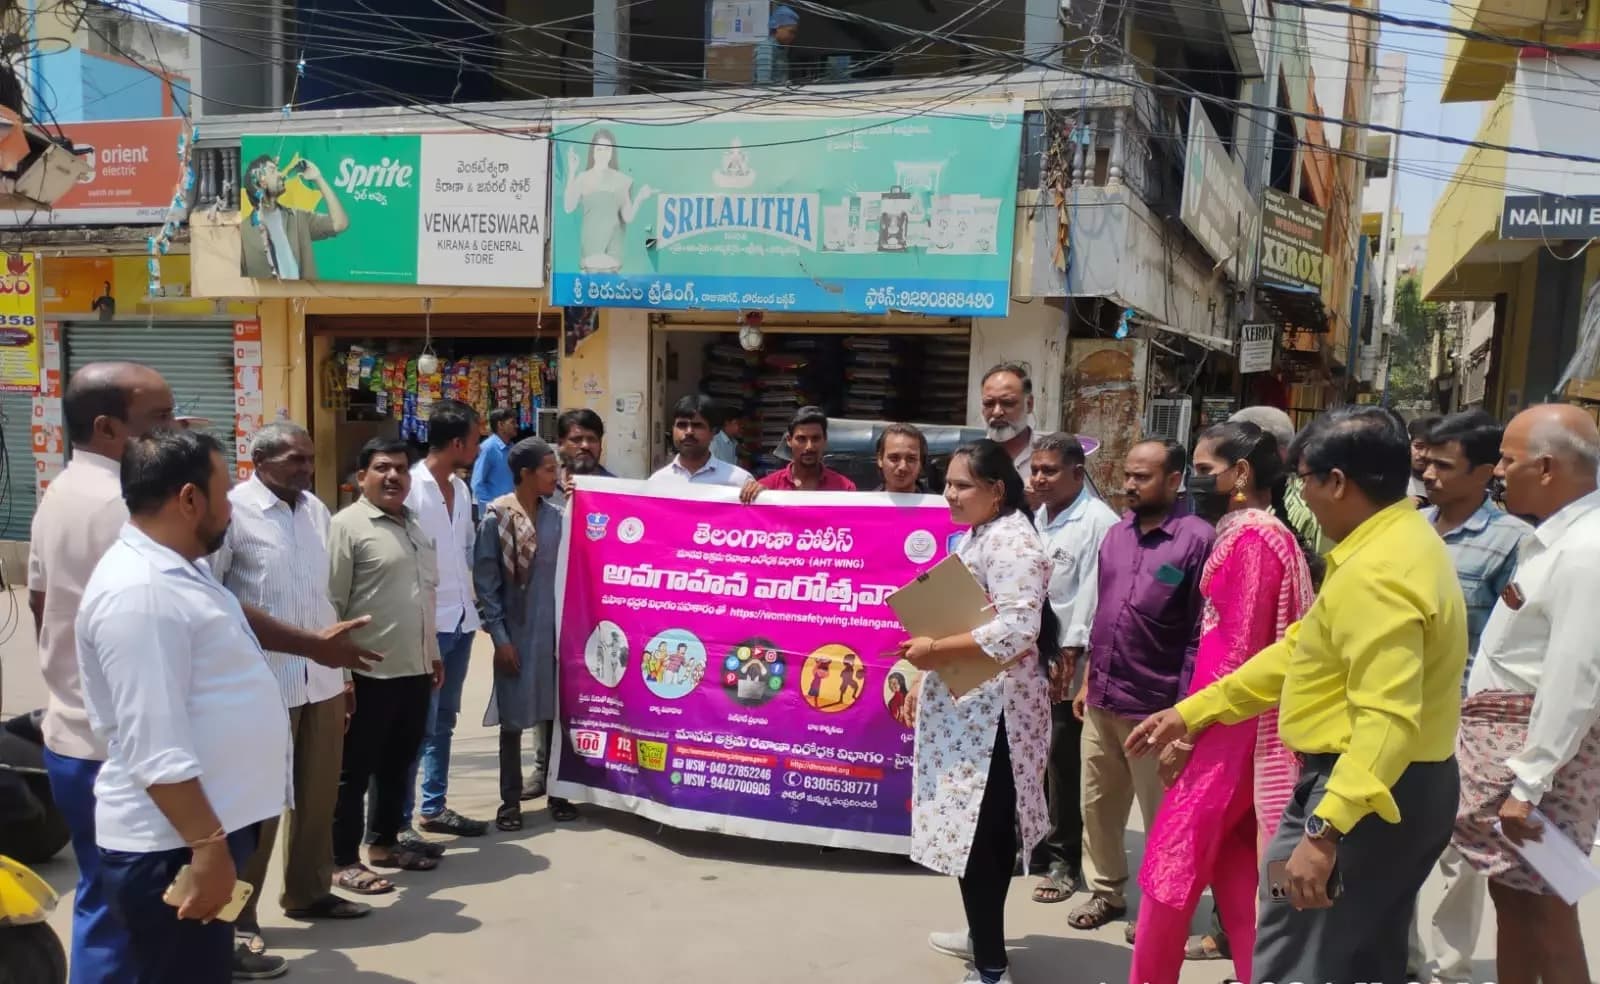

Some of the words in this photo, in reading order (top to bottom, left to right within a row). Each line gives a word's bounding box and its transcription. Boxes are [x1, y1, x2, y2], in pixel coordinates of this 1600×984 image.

[102, 144, 148, 163] orient
[102, 165, 136, 176] electric
[334, 157, 413, 193] Sprite
[467, 181, 474, 193] &
[477, 178, 507, 193] జనరల్
[424, 212, 540, 234] VENKATESWARA
[662, 196, 812, 242] SRILALITHA
[1509, 207, 1583, 226] NALINI
[437, 239, 470, 251] KIRANA
[472, 240, 479, 251] &
[481, 240, 524, 252] GENERAL
[464, 253, 494, 265] STORE
[1261, 236, 1322, 285] XEROX
[588, 282, 643, 301] తిరుమల
[1245, 325, 1274, 342] XEROX
[693, 522, 793, 550] తెలంగాణా
[796, 526, 854, 553] పోలీస్
[809, 557, 832, 568] (AHT
[834, 558, 864, 569] WING)
[603, 563, 748, 597] అవగాహన
[576, 738, 600, 752] 100
[675, 728, 713, 744] మానవ
[715, 734, 748, 750] అక్రమ
[749, 738, 790, 753] రవాణా
[792, 741, 834, 759] నిరోధక
[837, 748, 884, 764] విభాగం
[727, 765, 772, 781] 27852246
[803, 775, 879, 796] 6305538771
